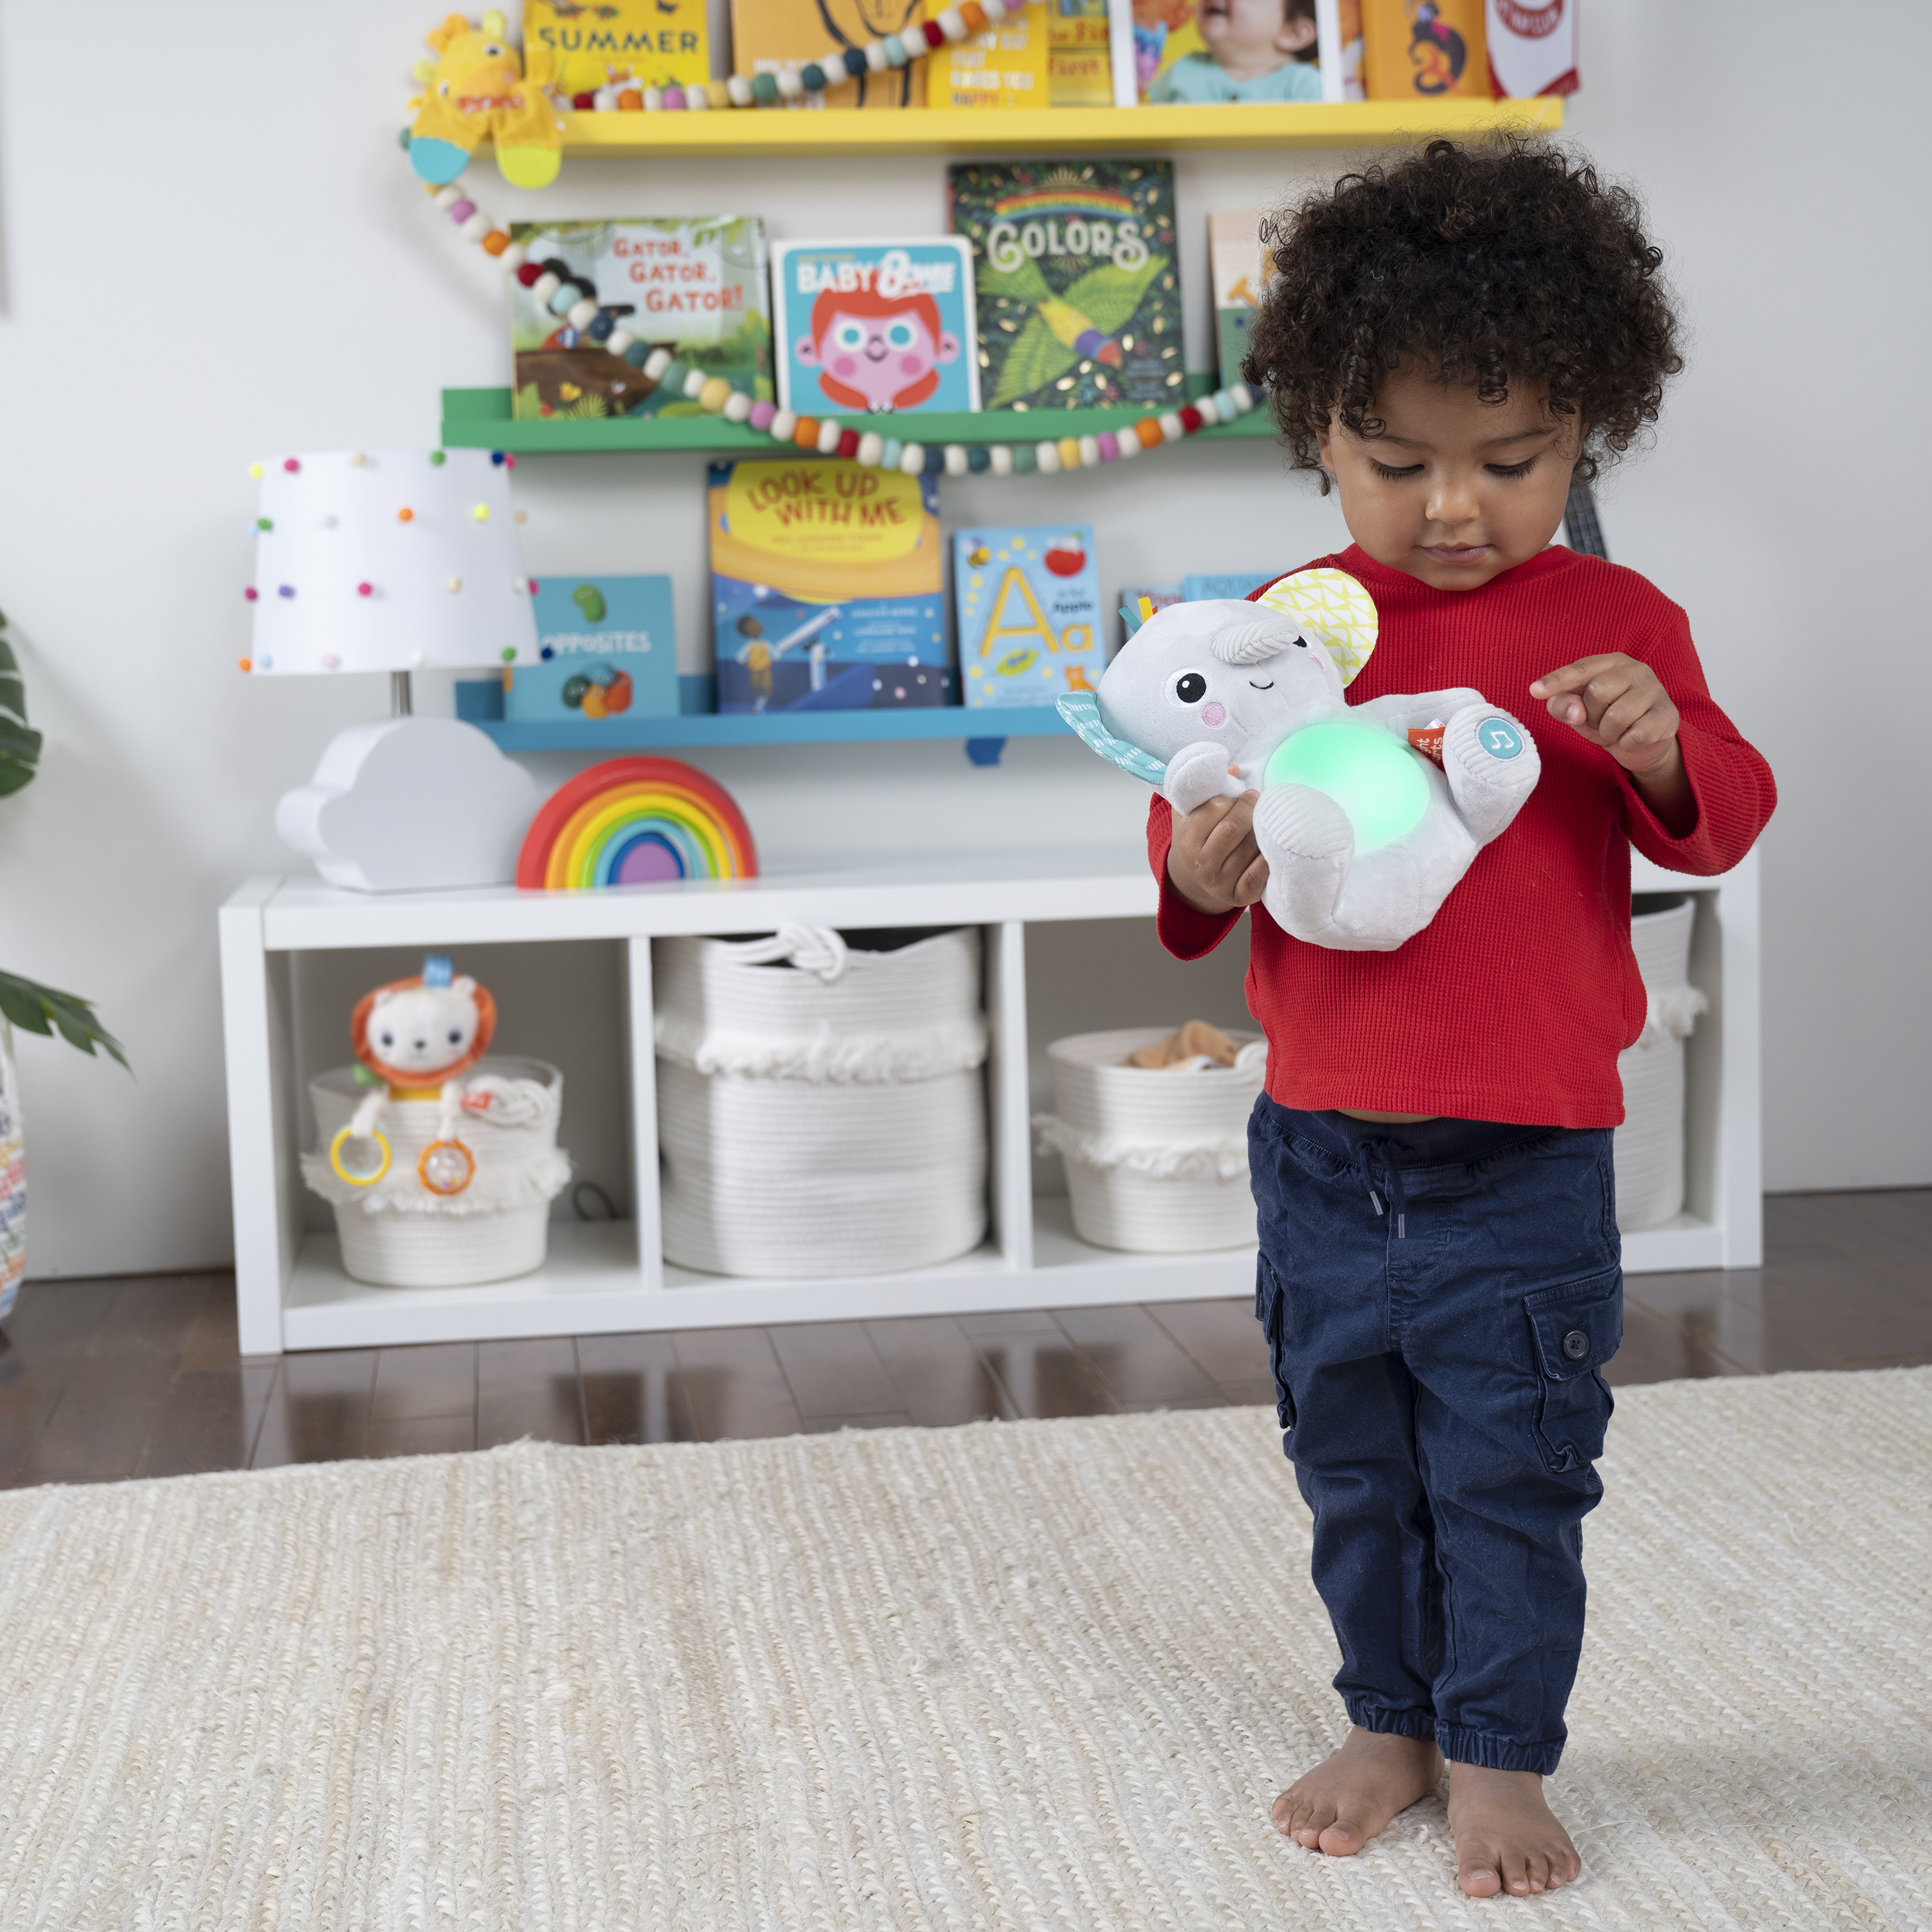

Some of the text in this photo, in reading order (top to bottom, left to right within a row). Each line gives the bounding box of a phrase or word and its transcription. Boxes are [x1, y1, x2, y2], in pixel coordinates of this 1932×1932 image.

[537, 27, 699, 54] SUMMER
[1002, 71, 1034, 91] YOU
[986, 219, 1151, 273] COLORS
[796, 260, 875, 294] BABY
[746, 468, 880, 513] LOOK UP
[775, 495, 909, 529] WITH ME
[542, 630, 652, 655] OPPOSITES
